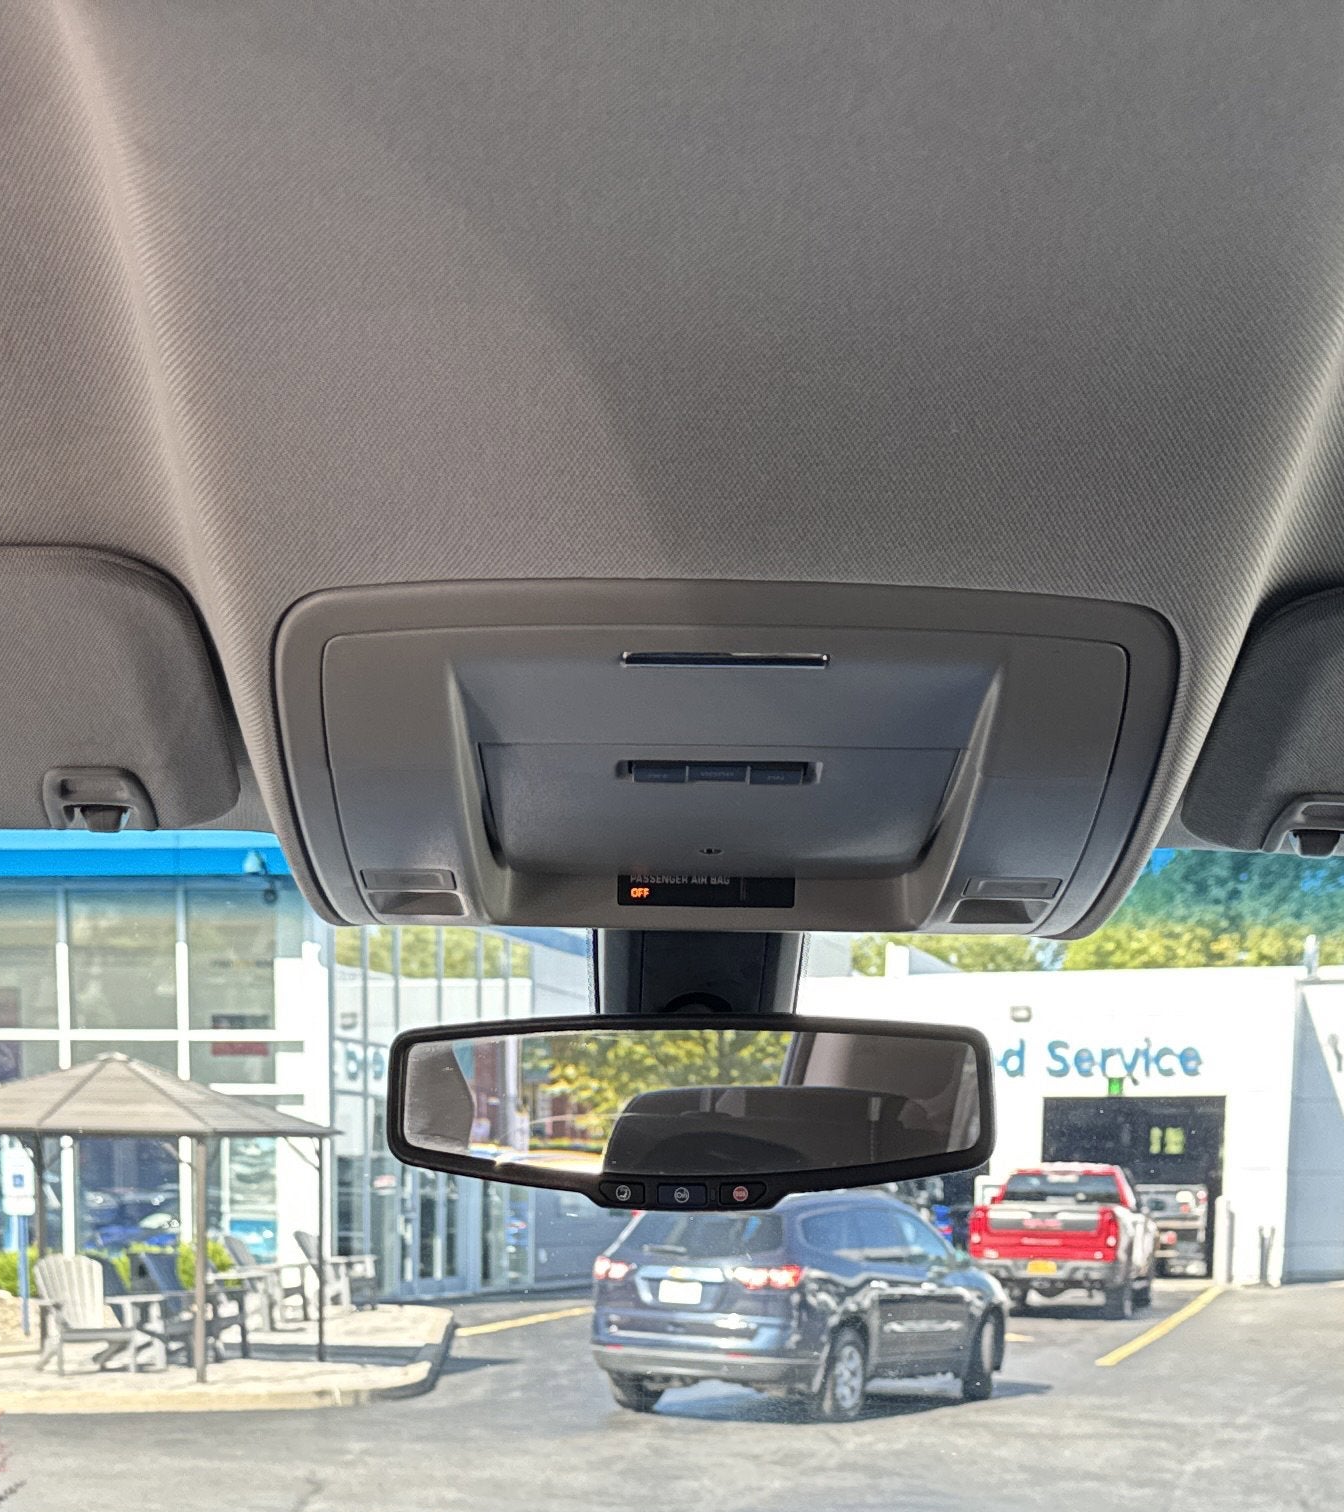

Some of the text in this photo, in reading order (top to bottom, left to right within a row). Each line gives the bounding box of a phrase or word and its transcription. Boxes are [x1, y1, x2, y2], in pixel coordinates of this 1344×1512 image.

[630, 875, 730, 885] PASSENGER AIR BAG
[630, 888, 650, 898] OFF
[1047, 1037, 1202, 1077] Service
